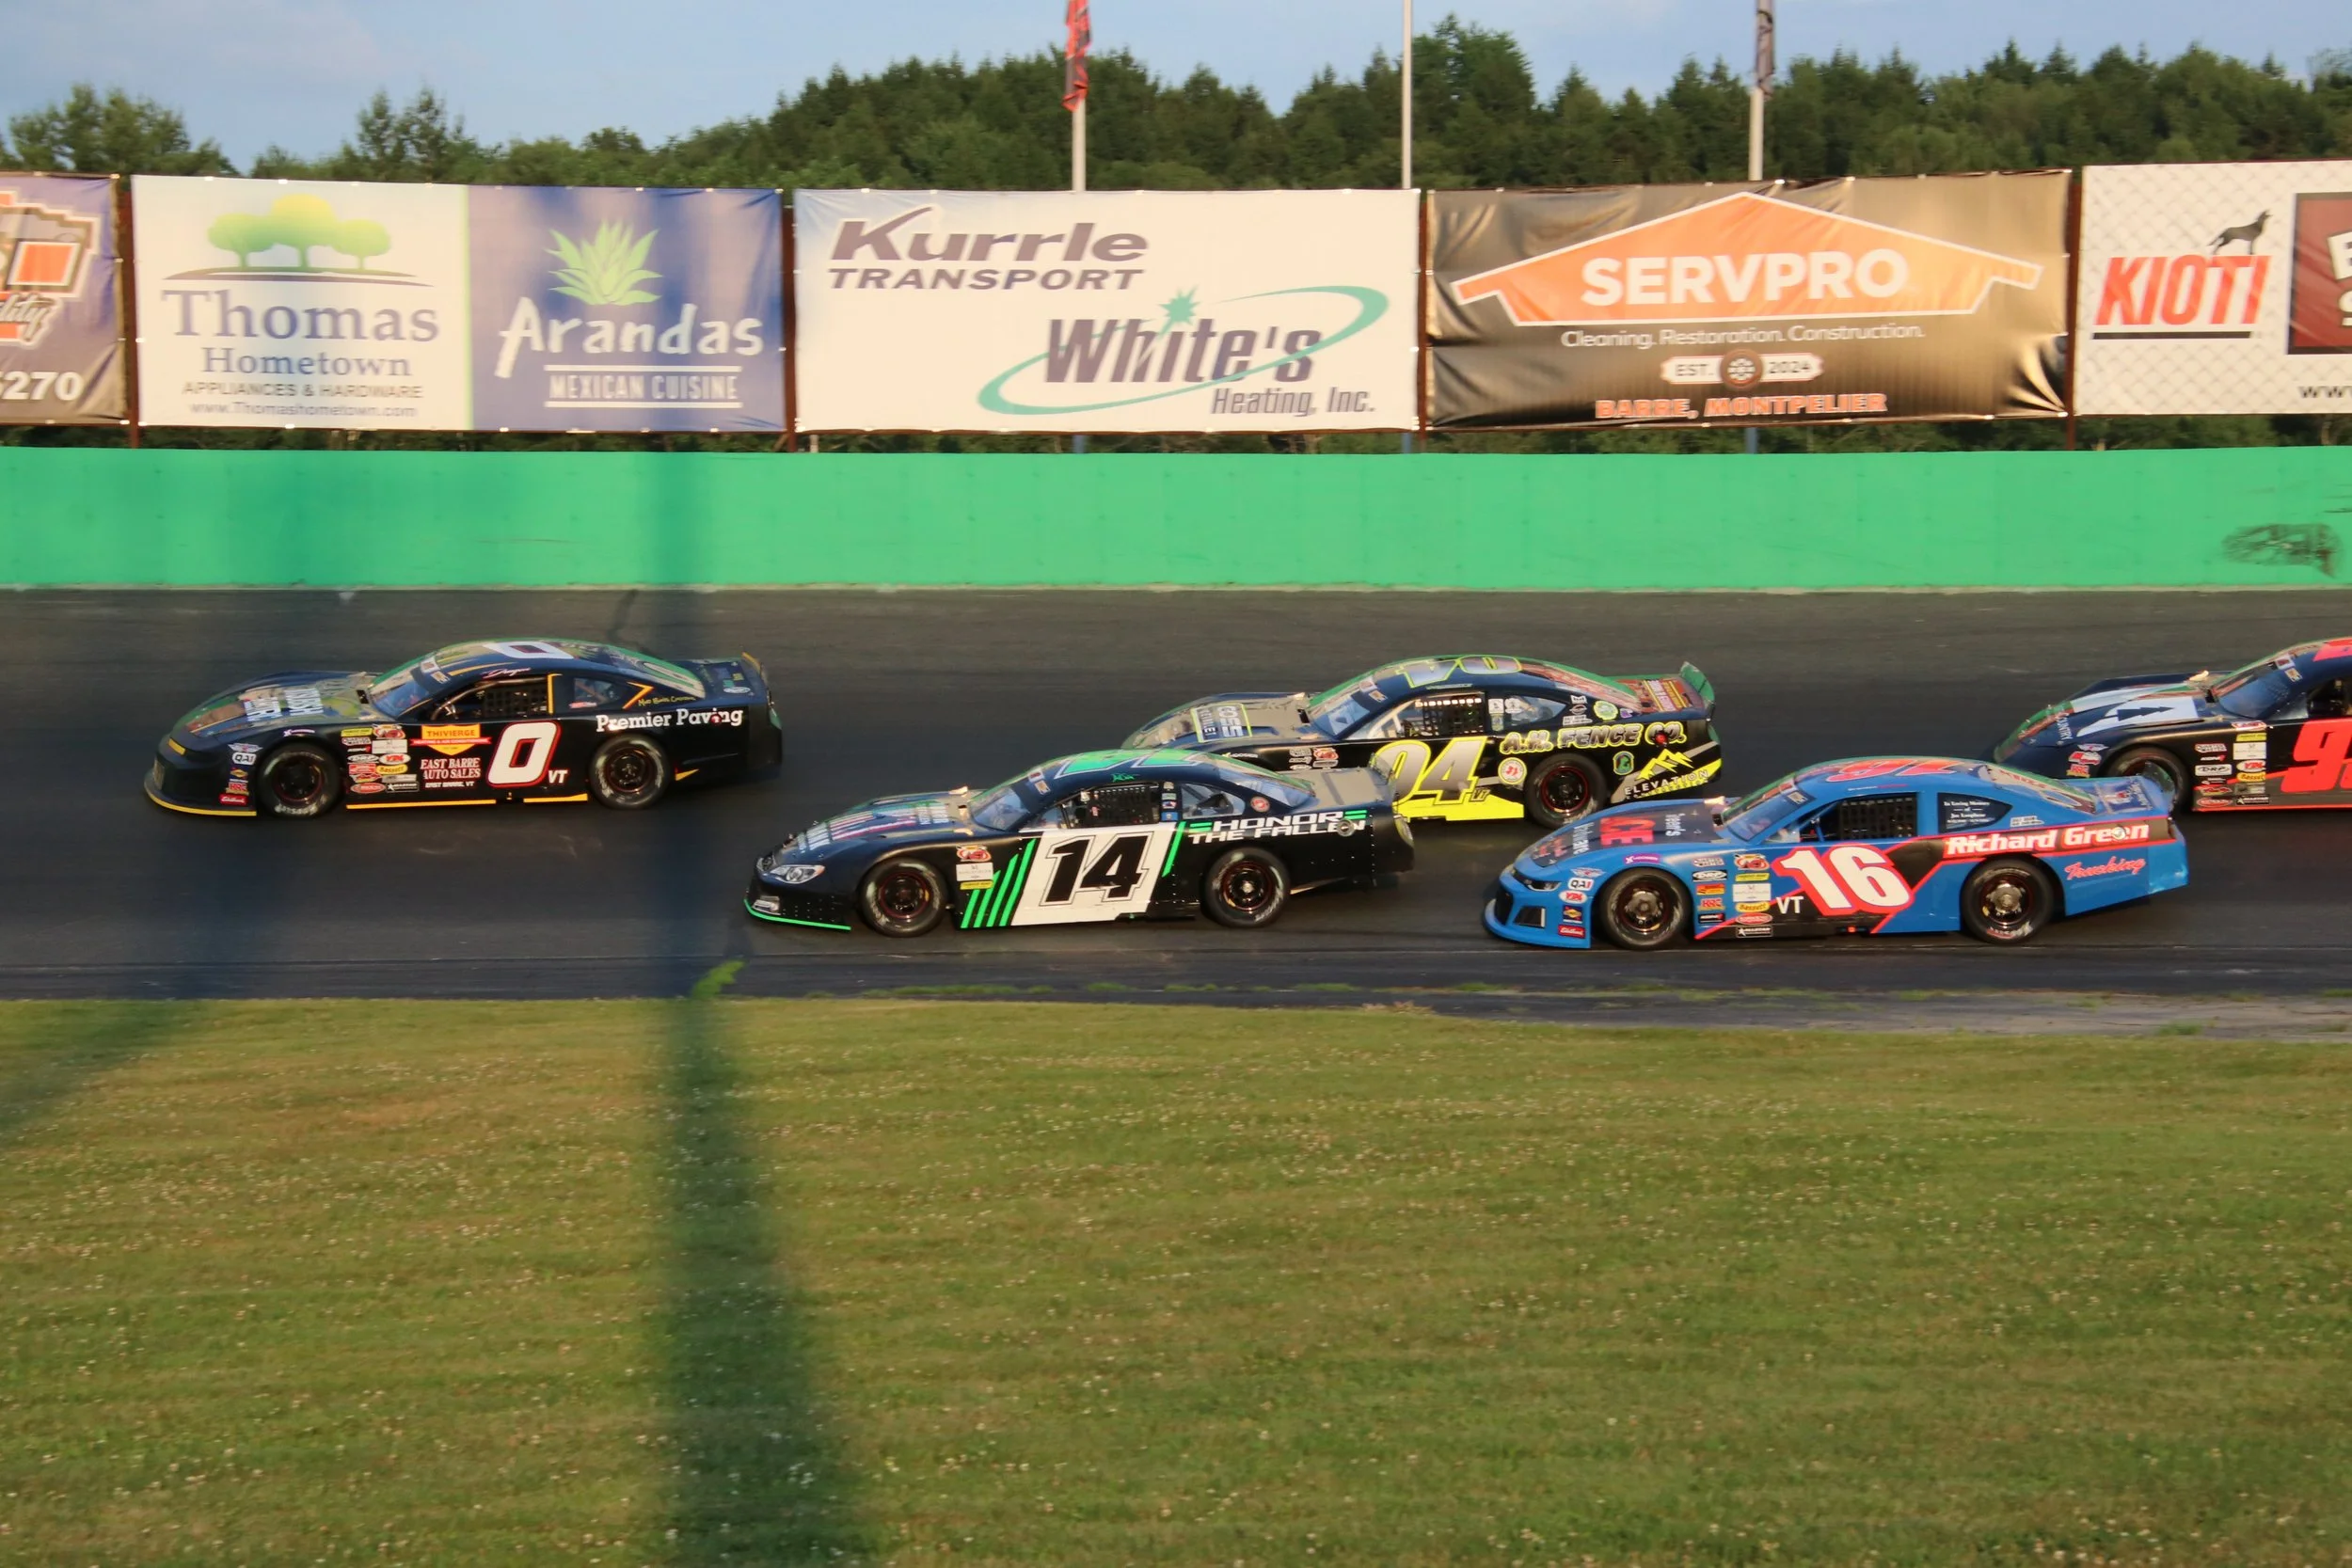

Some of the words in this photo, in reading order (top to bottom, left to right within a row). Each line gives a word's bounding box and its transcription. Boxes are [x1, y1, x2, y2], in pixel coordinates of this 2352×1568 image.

[831, 206, 1148, 261] Kurrle
[828, 268, 1144, 291] TRANSPORT
[1582, 248, 1909, 306] SERVPRO
[2092, 254, 2272, 325] KIOTI
[161, 289, 439, 341] Thomas
[494, 296, 763, 378] Arandas
[1561, 330, 1658, 350] Cleaning.
[1660, 326, 1785, 345] Restoration.
[1788, 323, 1926, 341] Construction.
[201, 347, 412, 376] Hometown
[1045, 318, 1322, 383] White's
[1768, 361, 1811, 375] 2024
[183, 381, 298, 397] APPLIANCES
[302, 383, 314, 397] &
[319, 384, 424, 399] HARDWARE
[548, 375, 645, 400] MEXICAN
[651, 375, 738, 400] CUISINE
[1326, 386, 1375, 413] Inc.
[1596, 398, 1699, 420] BARRE,
[1704, 393, 1888, 417] MONTPELIER
[426, 729, 476, 737] THIVIERGE
[596, 711, 673, 733] Premier
[675, 707, 744, 727] Paving
[1558, 723, 1643, 750] FENCE
[421, 759, 448, 769] EAST
[449, 757, 481, 768] BARRE
[486, 721, 560, 787] 0
[423, 769, 449, 779] AUTO
[450, 768, 481, 779] SALES
[548, 769, 568, 784] VT
[1625, 768, 1708, 796] ELEVATION
[1214, 811, 1344, 832] HONOR
[1188, 829, 1246, 845] THE
[1947, 829, 2058, 855] Richard
[1040, 832, 1150, 906] 14
[1775, 844, 1913, 912] 16
[1774, 895, 1804, 915] VT
